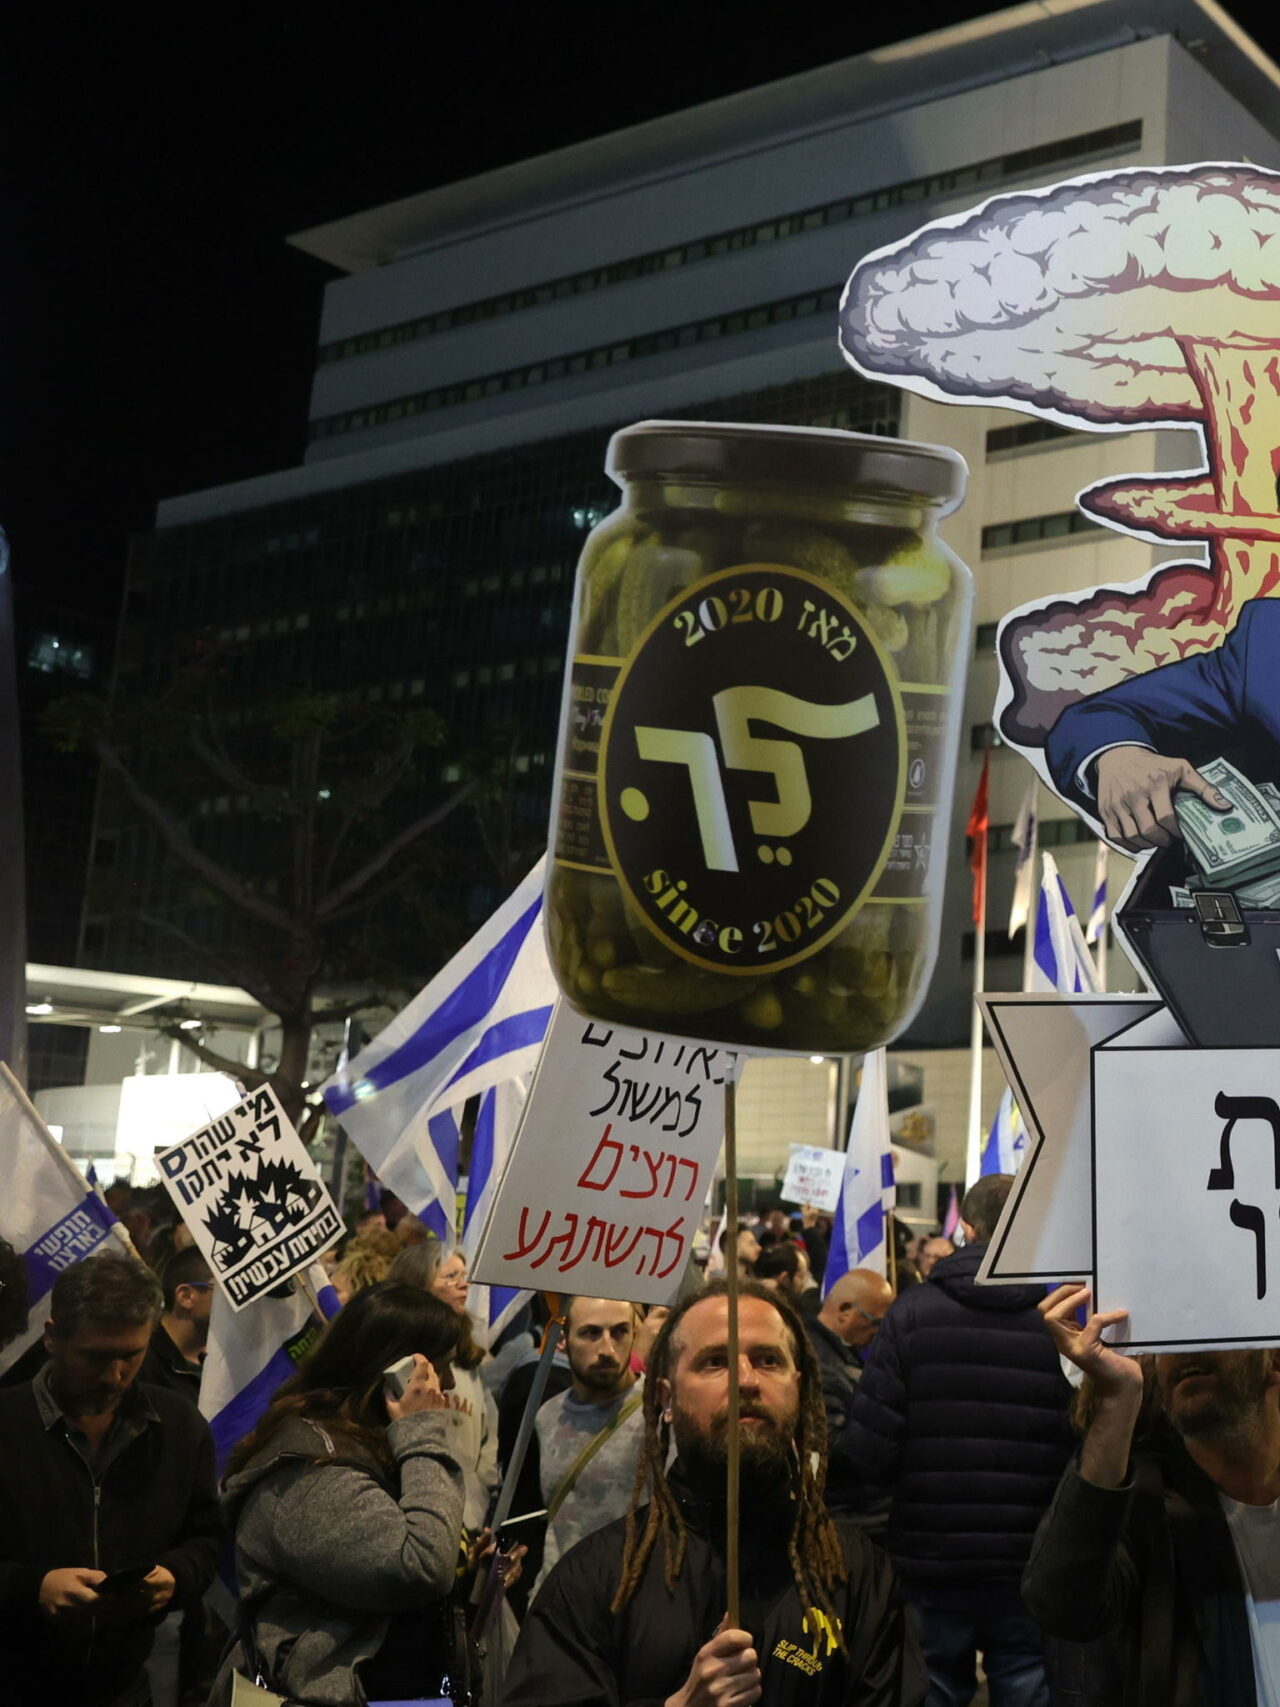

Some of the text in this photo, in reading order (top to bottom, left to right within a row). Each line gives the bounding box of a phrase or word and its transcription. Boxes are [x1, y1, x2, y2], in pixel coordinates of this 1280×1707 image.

[673, 587, 857, 661] מאז 2020
[643, 870, 840, 953] since 2020
[159, 1090, 276, 1180] מי שהרס
[589, 1060, 702, 1137] למשול
[175, 1115, 282, 1206] לא יתקן
[577, 1123, 700, 1201] רוצים
[33, 1210, 92, 1256] חופשי
[47, 1223, 106, 1272] בארצנו
[229, 1209, 338, 1300] בחירות עכשיו!
[503, 1206, 685, 1279] להשתגע
[772, 1647, 817, 1676] THE CRACKS
[777, 1639, 798, 1651] SLIP
